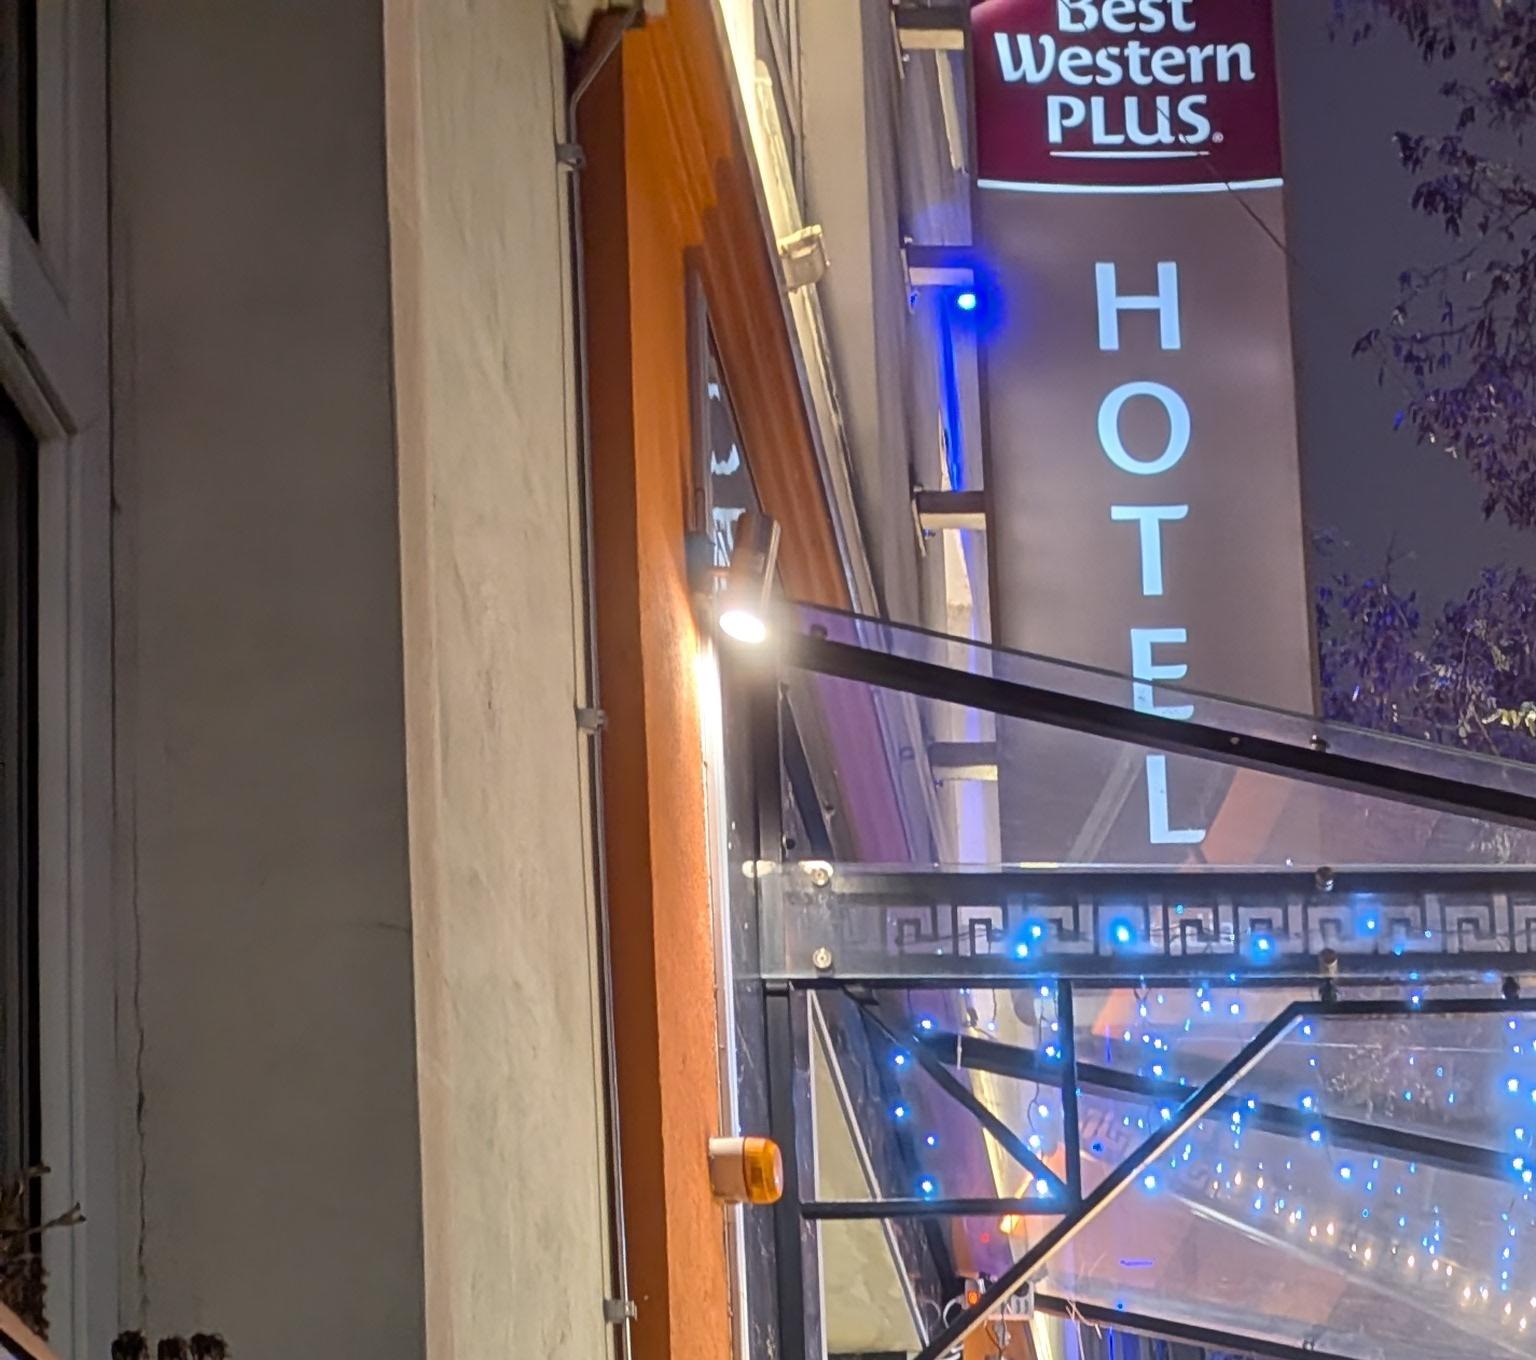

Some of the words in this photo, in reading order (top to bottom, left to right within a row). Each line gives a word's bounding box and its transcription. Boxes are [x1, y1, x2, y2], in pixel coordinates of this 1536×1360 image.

[1056, 0, 1197, 33] Best
[993, 32, 1256, 86] Western
[1094, 261, 1207, 845] HOTEL
